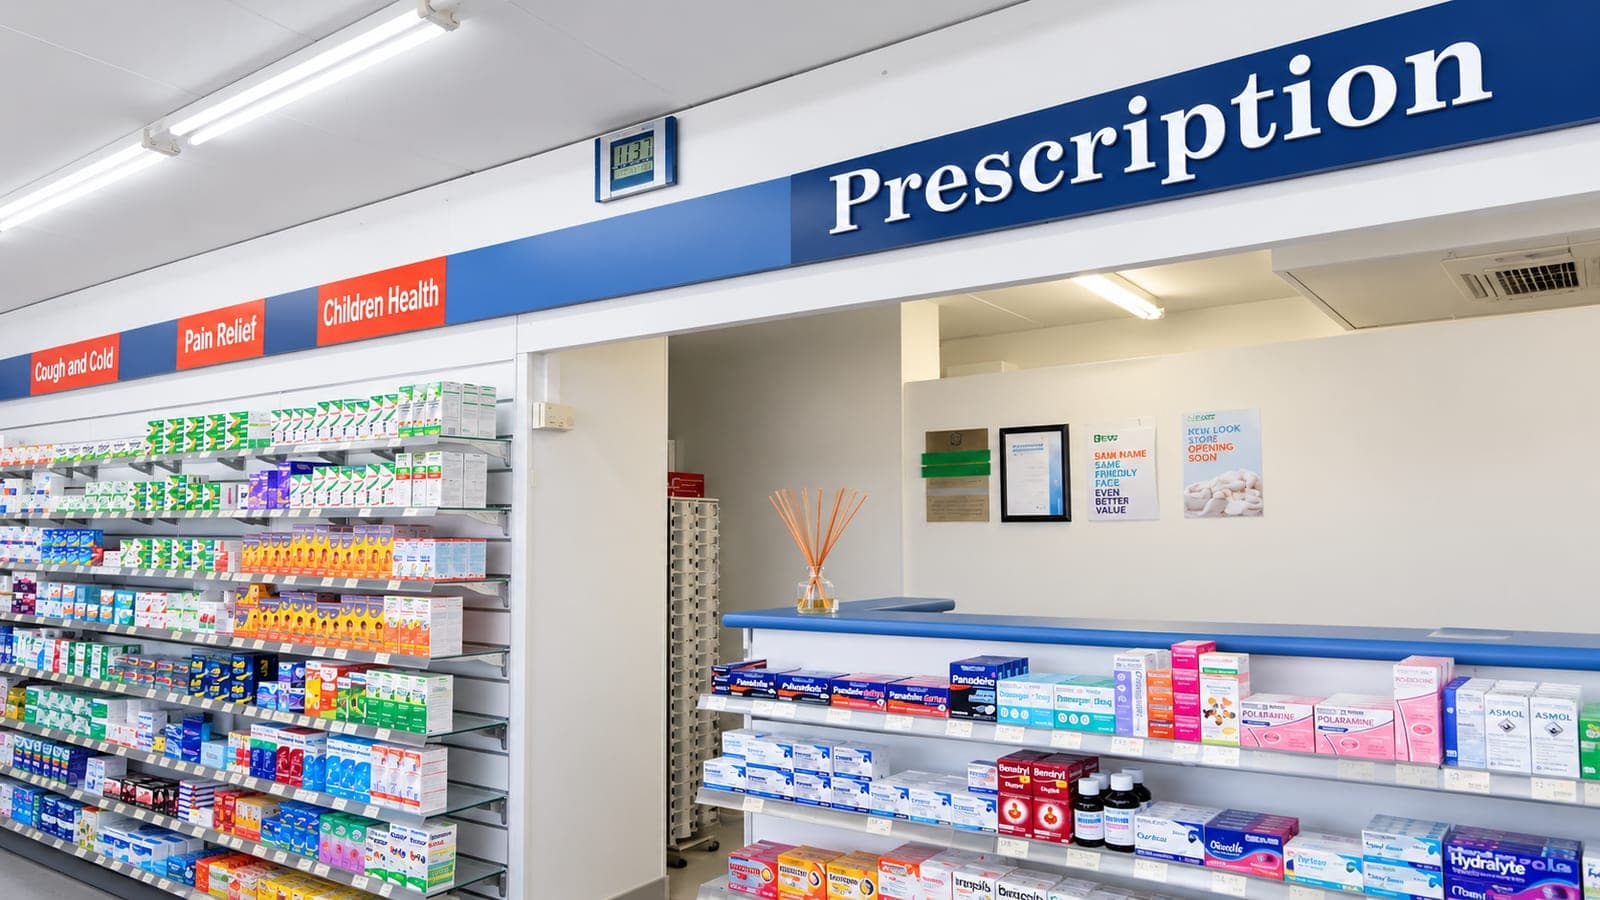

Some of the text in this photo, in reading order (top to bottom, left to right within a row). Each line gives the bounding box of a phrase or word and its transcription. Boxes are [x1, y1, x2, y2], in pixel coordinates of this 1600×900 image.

[829, 38, 1493, 235] Prescription
[323, 278, 439, 327] Children Health
[185, 314, 257, 353] Pain Relief
[35, 346, 114, 383] Cough and Cold
[1213, 424, 1241, 434] LOOK
[1188, 434, 1218, 444] STORE
[1188, 442, 1234, 453] OPENING
[1119, 450, 1147, 459] NAME
[1188, 453, 1217, 462] SOON
[1095, 460, 1121, 469] SAME
[1095, 479, 1120, 487] FACE
[1095, 488, 1120, 497] EVEN
[1095, 497, 1129, 506] BETTER
[1096, 506, 1127, 515] VALUE
[1489, 708, 1525, 719] ASMOL
[1535, 711, 1573, 722] ASMOL
[1317, 714, 1375, 728] POLARAMINE
[1450, 851, 1526, 876] Hydralyte
